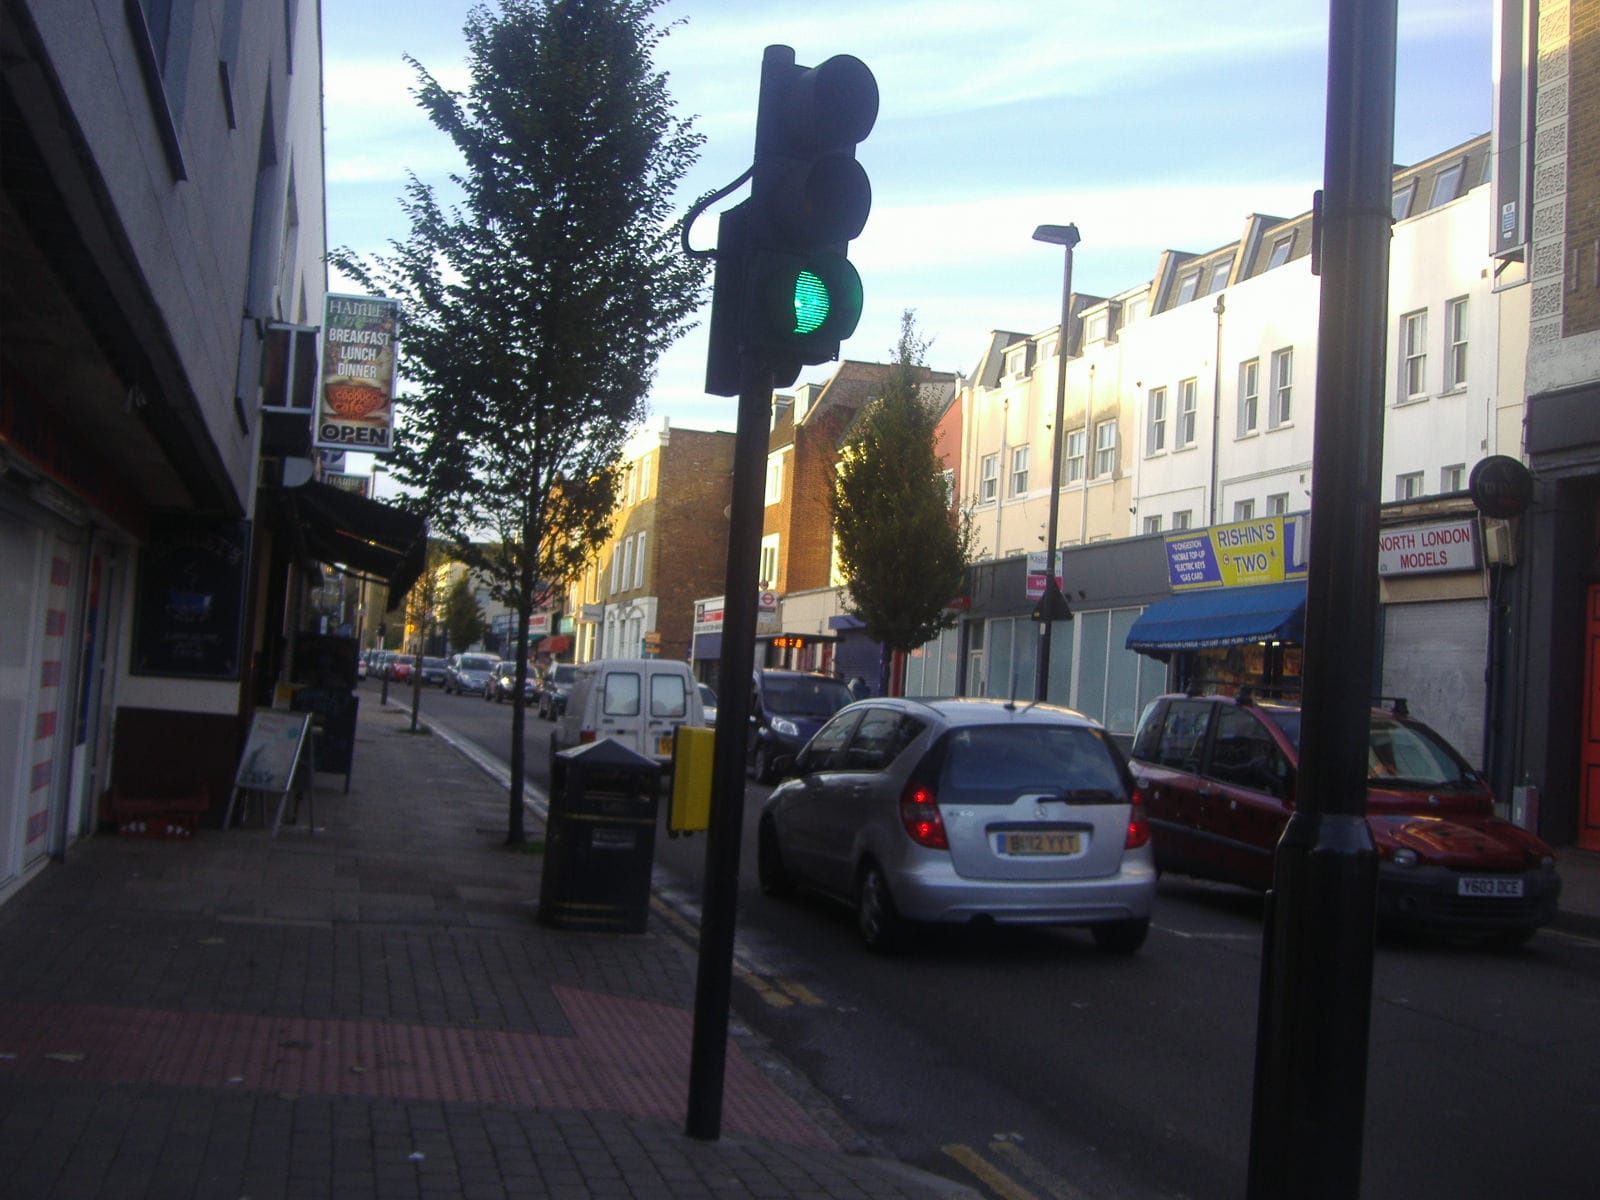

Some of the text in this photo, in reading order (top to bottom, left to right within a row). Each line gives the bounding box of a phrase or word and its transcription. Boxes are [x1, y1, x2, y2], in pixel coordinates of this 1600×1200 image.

[329, 327, 390, 346] BREAKFAST
[341, 347, 377, 361] LUNCH
[337, 363, 377, 378] DINNER
[320, 424, 388, 444] OPEN
[1217, 523, 1275, 547] RISHIN'S
[1378, 527, 1470, 552] NORTH LONDON
[1233, 554, 1267, 574] TWO
[1400, 550, 1448, 569] MODELS
